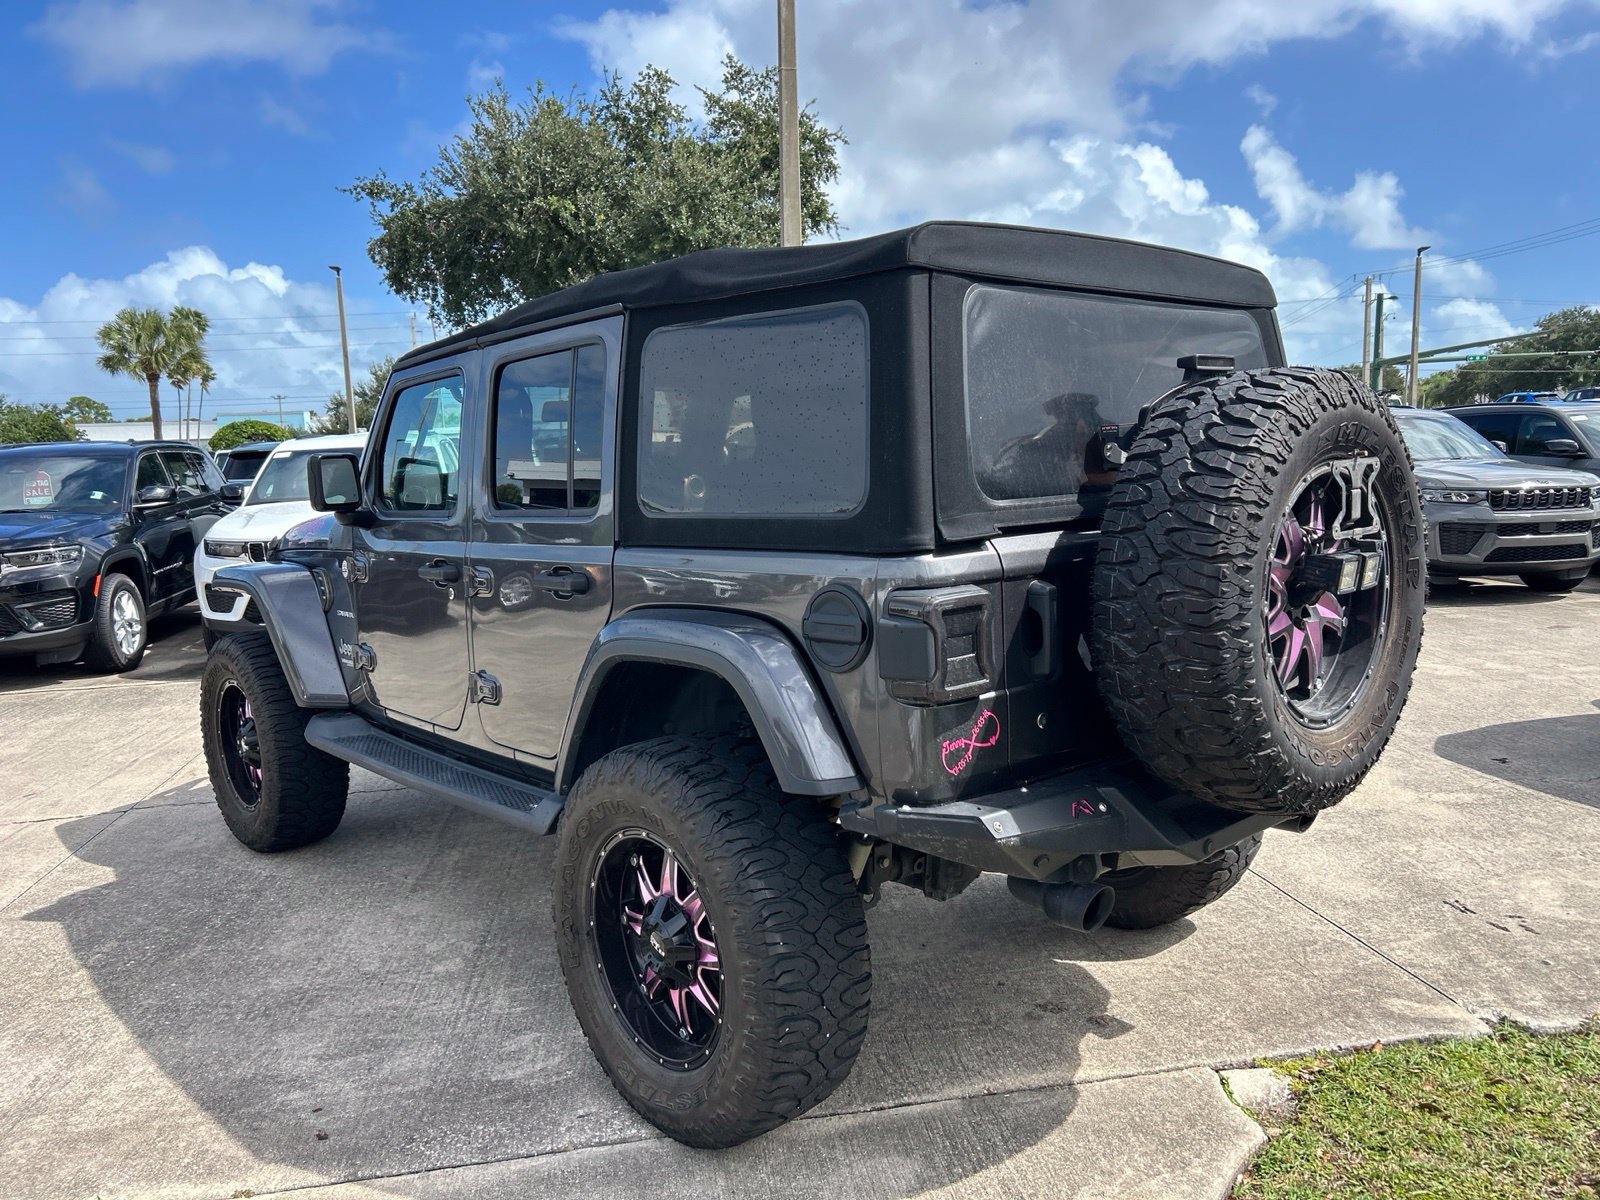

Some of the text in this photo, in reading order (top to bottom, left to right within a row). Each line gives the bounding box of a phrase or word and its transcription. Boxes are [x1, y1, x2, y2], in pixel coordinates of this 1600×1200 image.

[25, 488, 51, 496] SALE
[1336, 420, 1419, 591] MILESTAR
[942, 738, 965, 754] Jenny
